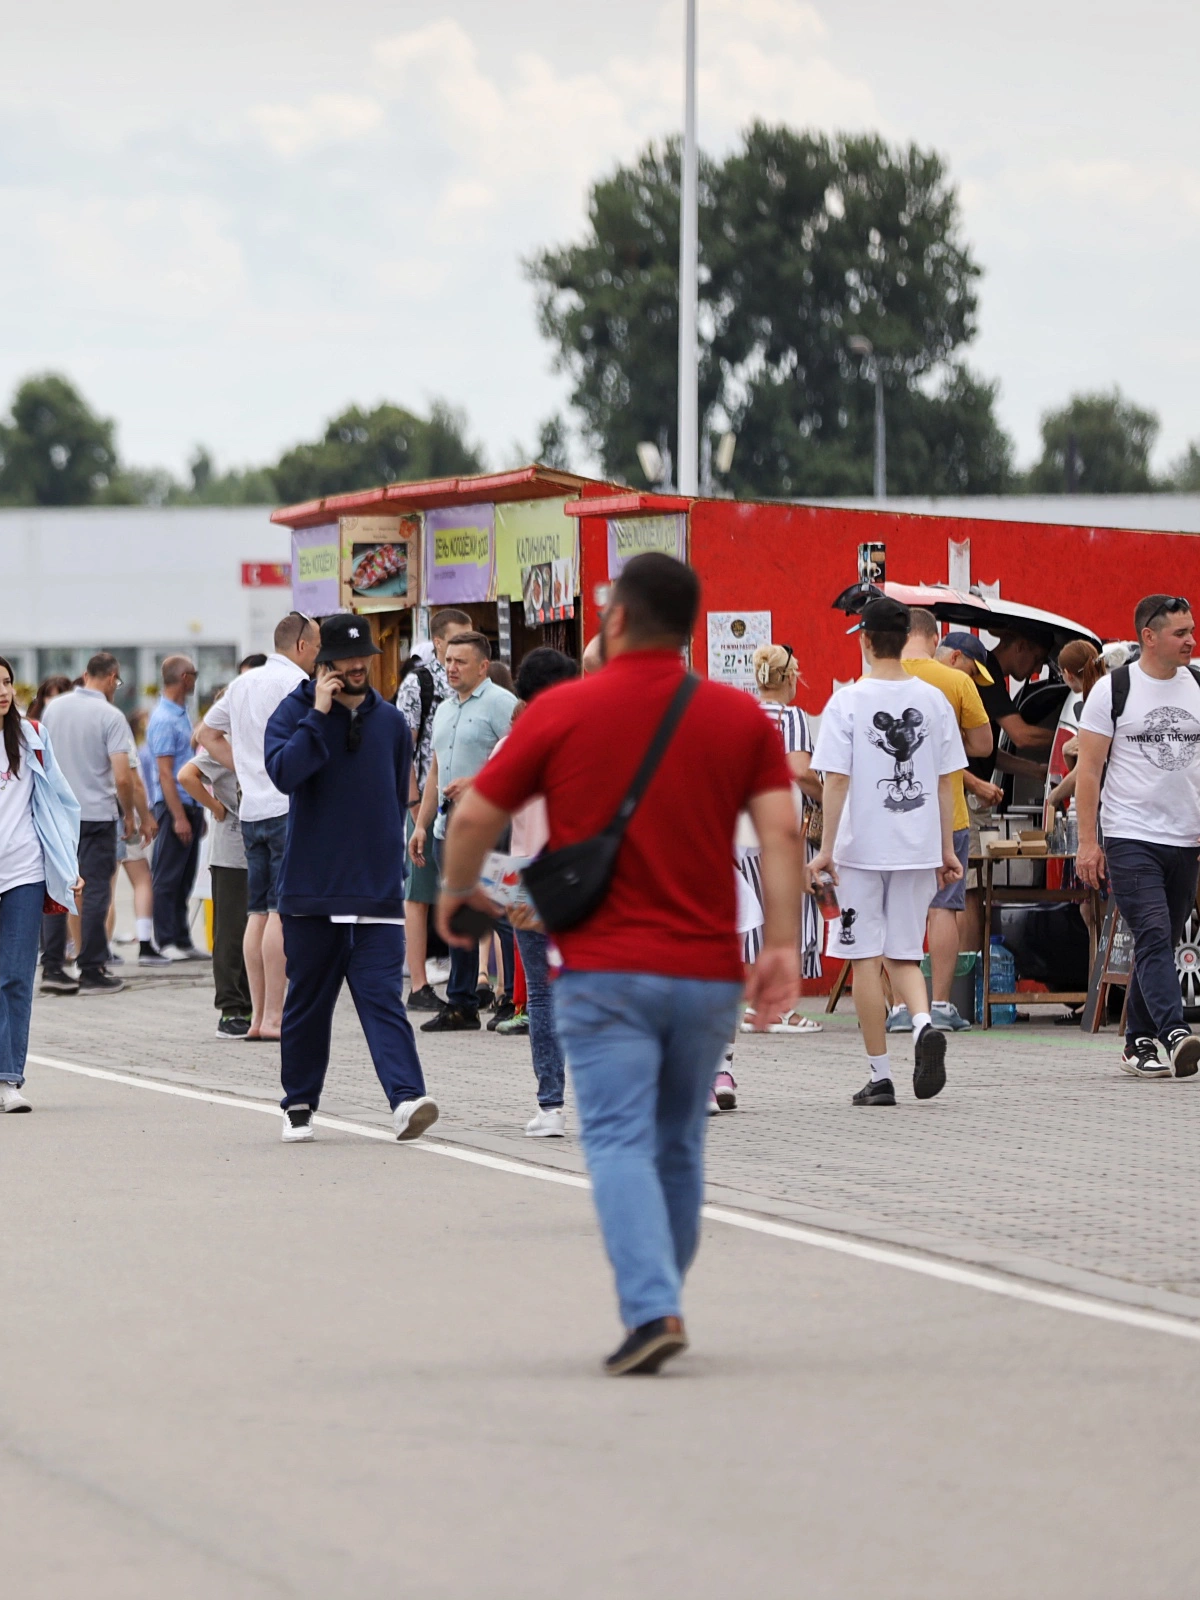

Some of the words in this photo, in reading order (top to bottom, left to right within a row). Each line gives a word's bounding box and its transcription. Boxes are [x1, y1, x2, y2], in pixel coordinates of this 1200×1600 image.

[435, 538, 449, 559] ДЕНЬ
[450, 532, 478, 558] МОЛОДЁЖИ
[516, 534, 560, 564] КАЛИНИНГРАД
[724, 654, 736, 667] 27
[1126, 735, 1153, 743] THINK
[1154, 733, 1166, 743] OF
[1167, 733, 1184, 742] THE
